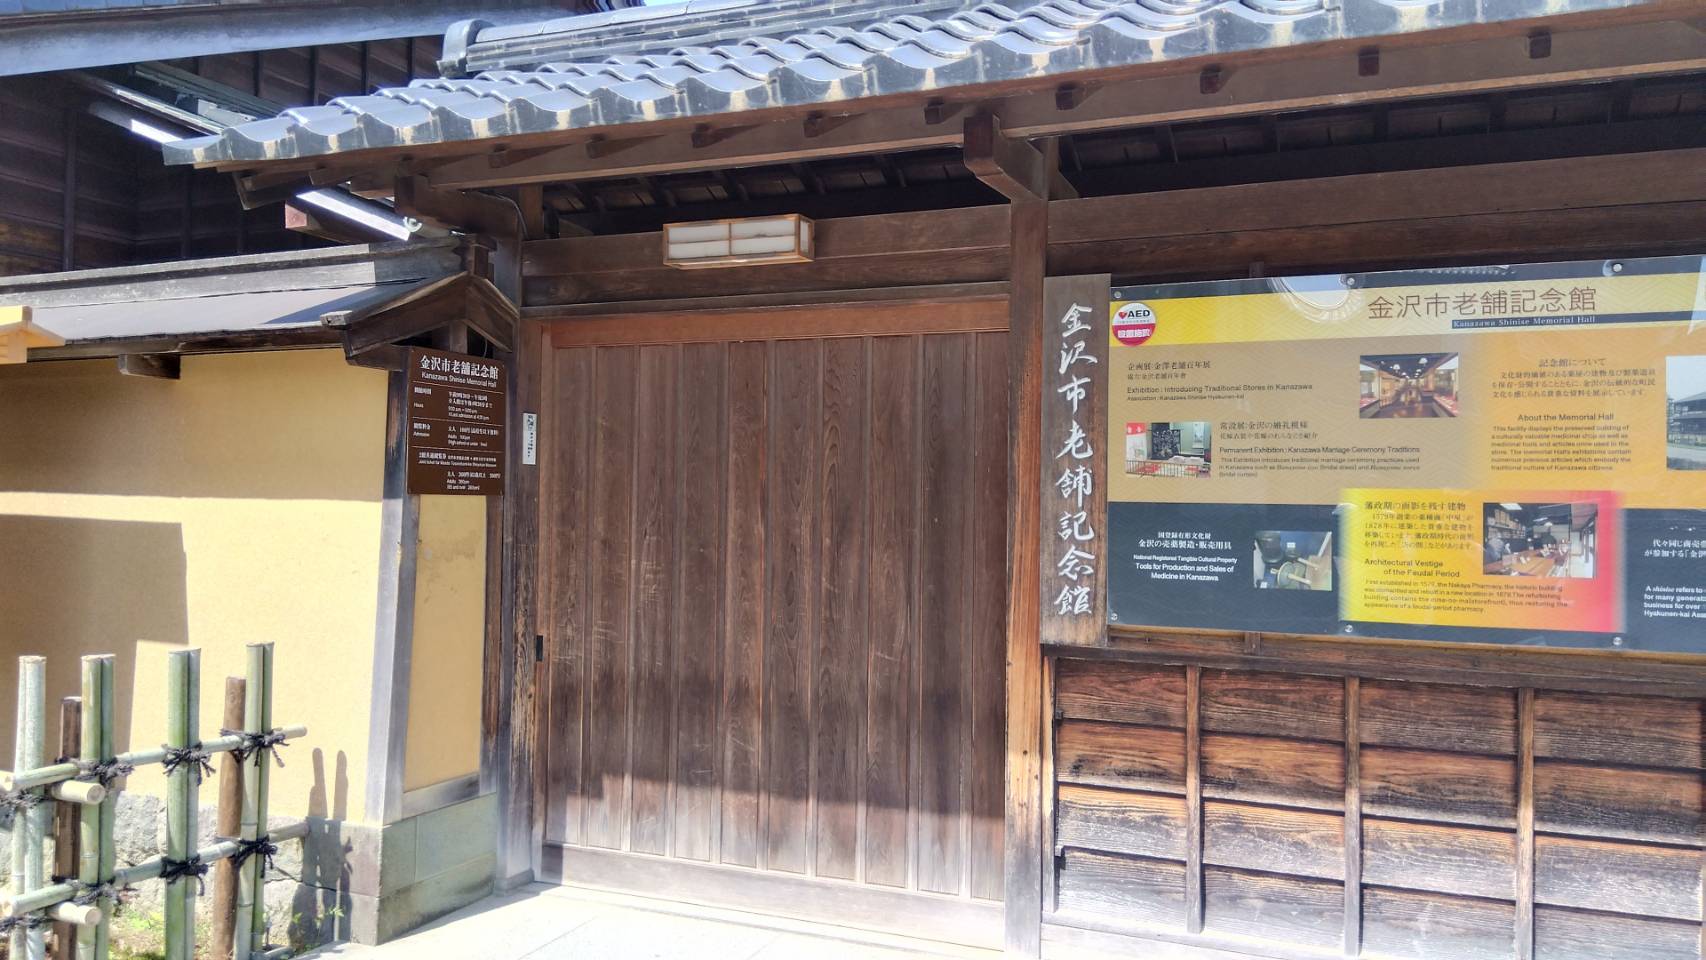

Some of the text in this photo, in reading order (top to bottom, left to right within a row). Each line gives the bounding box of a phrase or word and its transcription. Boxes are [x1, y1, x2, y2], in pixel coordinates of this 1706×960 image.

[1368, 286, 1597, 320] 金沢市老舗記念館
[1128, 309, 1150, 318] AED
[1453, 315, 1596, 328] Kanazawa Shinise Memorial Hall
[420, 354, 499, 380] 金沢市老舗記念館
[421, 371, 448, 382] Kanazawa
[1164, 386, 1203, 394] Introducing
[1558, 413, 1595, 421] Memorial
[1288, 446, 1320, 454] Kanazawa
[1055, 302, 1098, 615] 金沢市老舗記念館
[1136, 562, 1152, 570] Tools
[1162, 563, 1195, 571] Production
[1196, 564, 1209, 572] and
[1227, 565, 1234, 573] of
[1365, 559, 1444, 568] Architectural Vestige
[1151, 572, 1178, 580] Medicine
[1186, 573, 1219, 581] Kanazawa
[1407, 569, 1434, 577] Feudal
[1435, 570, 1460, 578] Period
[1656, 594, 1674, 602] many
